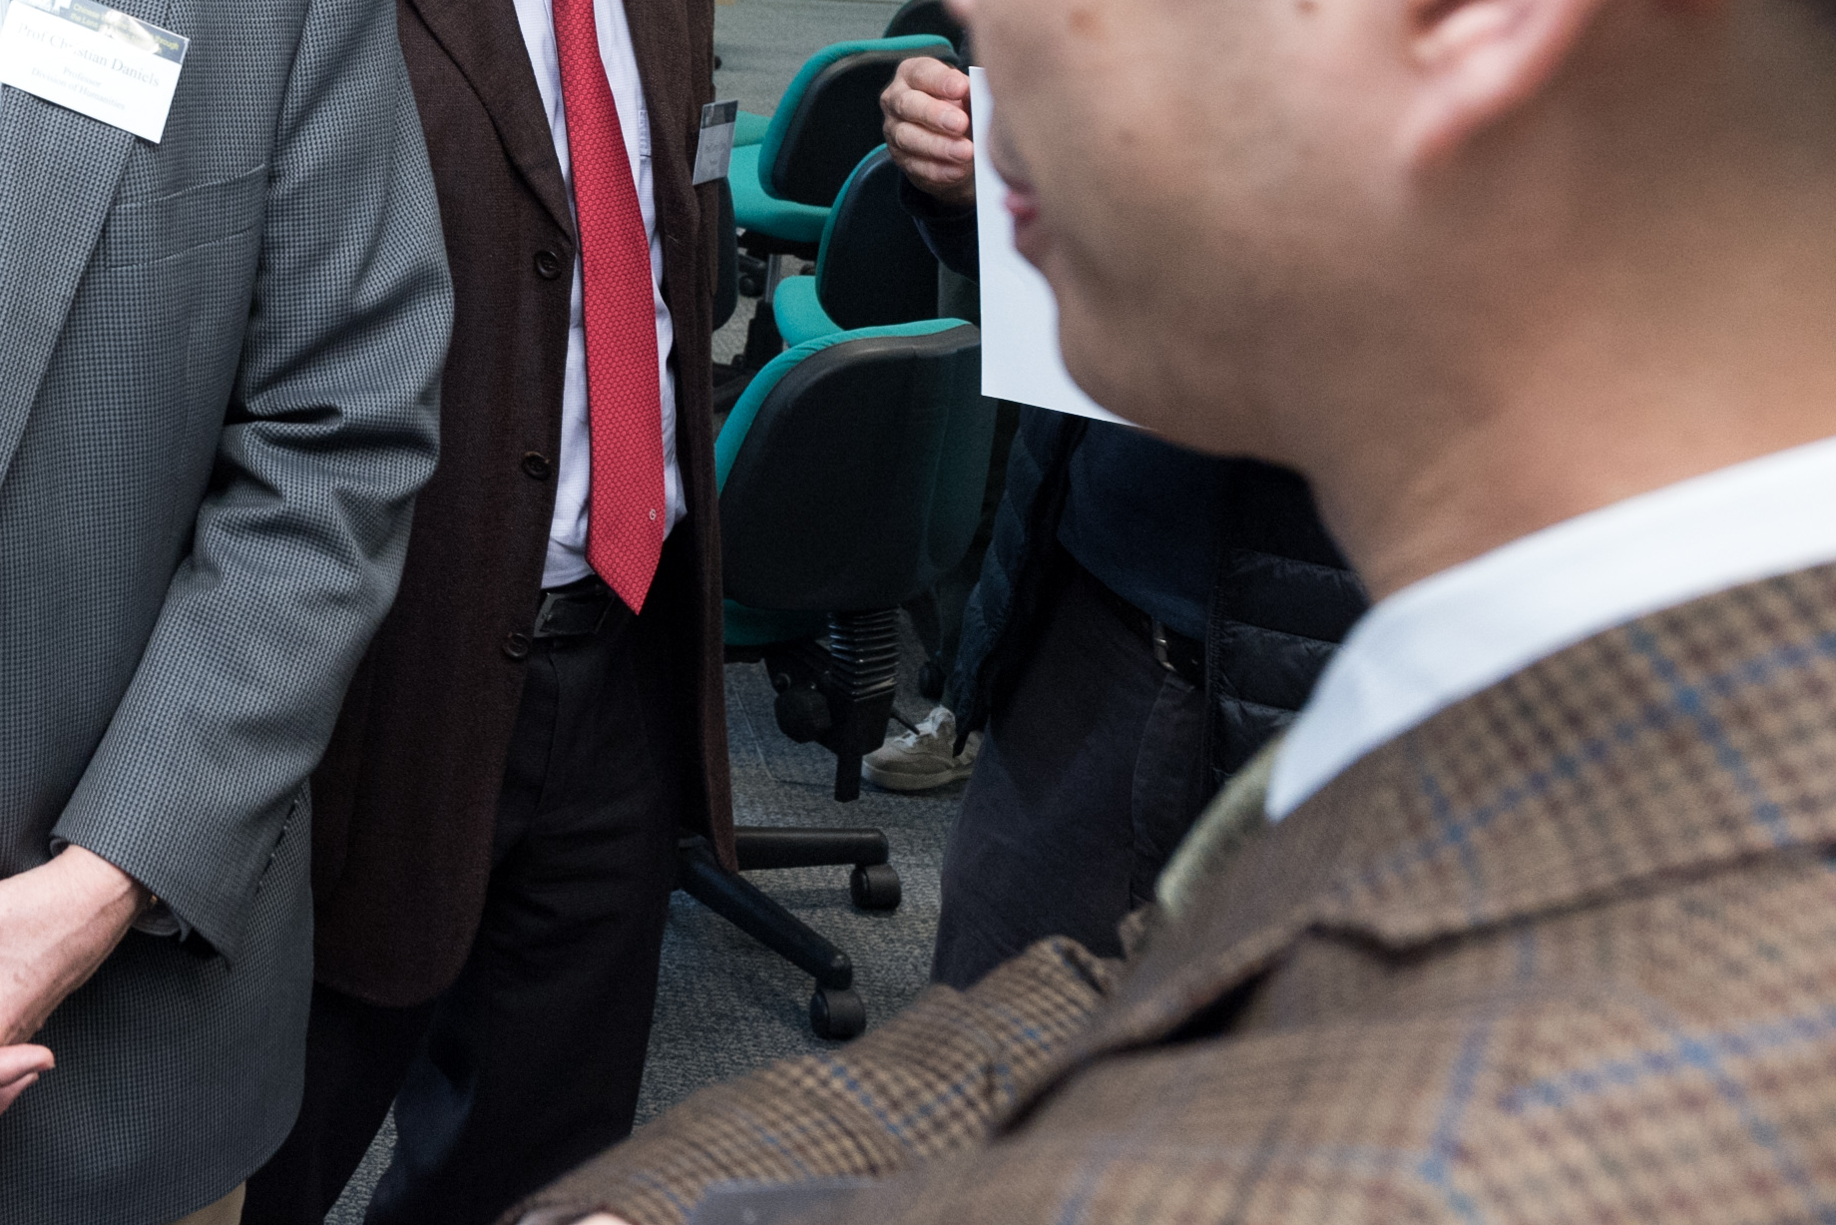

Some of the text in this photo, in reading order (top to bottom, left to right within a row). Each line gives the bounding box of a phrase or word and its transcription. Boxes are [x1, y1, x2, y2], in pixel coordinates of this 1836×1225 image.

[18, 22, 50, 42] Prof
[111, 58, 161, 88] Daniels
[31, 67, 125, 111] Division of Humanities
[63, 66, 102, 89] Professor
